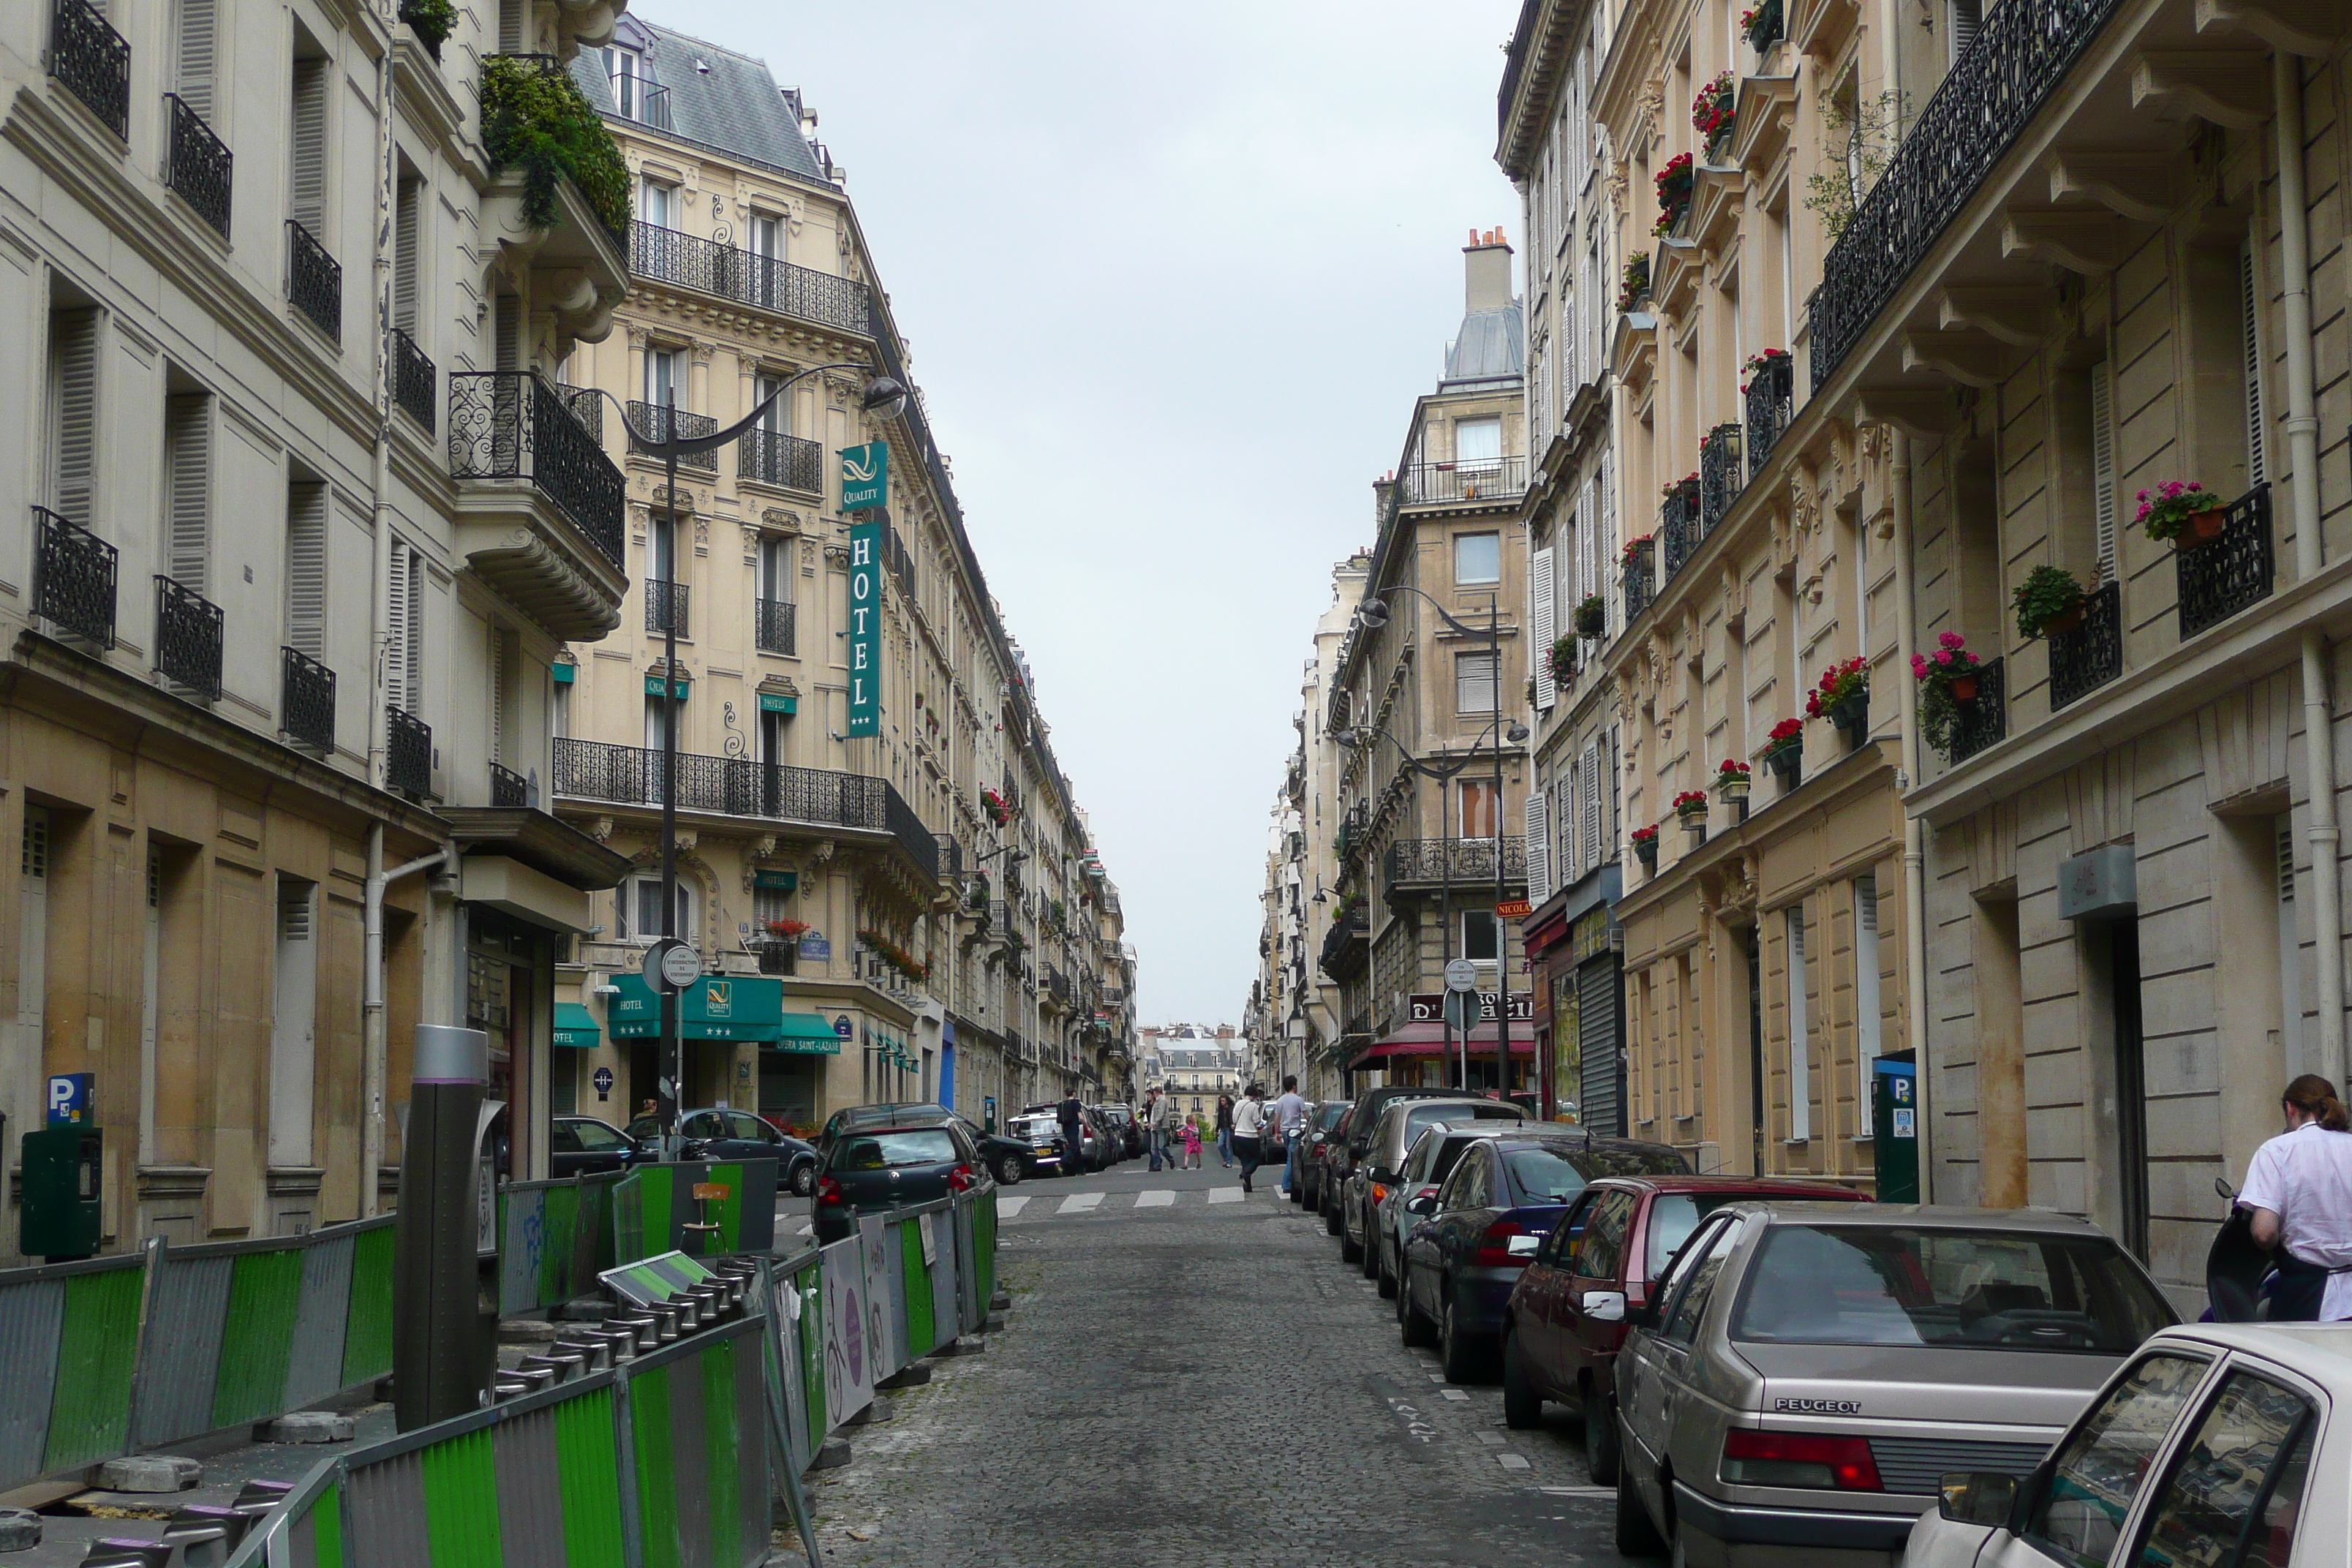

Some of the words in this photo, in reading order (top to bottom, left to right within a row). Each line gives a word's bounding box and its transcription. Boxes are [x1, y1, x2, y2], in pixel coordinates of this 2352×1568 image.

[844, 488, 878, 504] QUALITY
[853, 538, 870, 705] HOTEL
[649, 680, 682, 696] QUAY
[764, 698, 785, 709] HOTEL
[764, 875, 786, 886] HOTEL
[1499, 903, 1531, 913] NICOLA
[620, 1000, 643, 1010] HOTEL
[554, 1033, 574, 1042] OTEL
[50, 1079, 74, 1109] P
[1895, 1079, 1909, 1099] P
[1775, 1398, 1861, 1414] PEUGEOT
